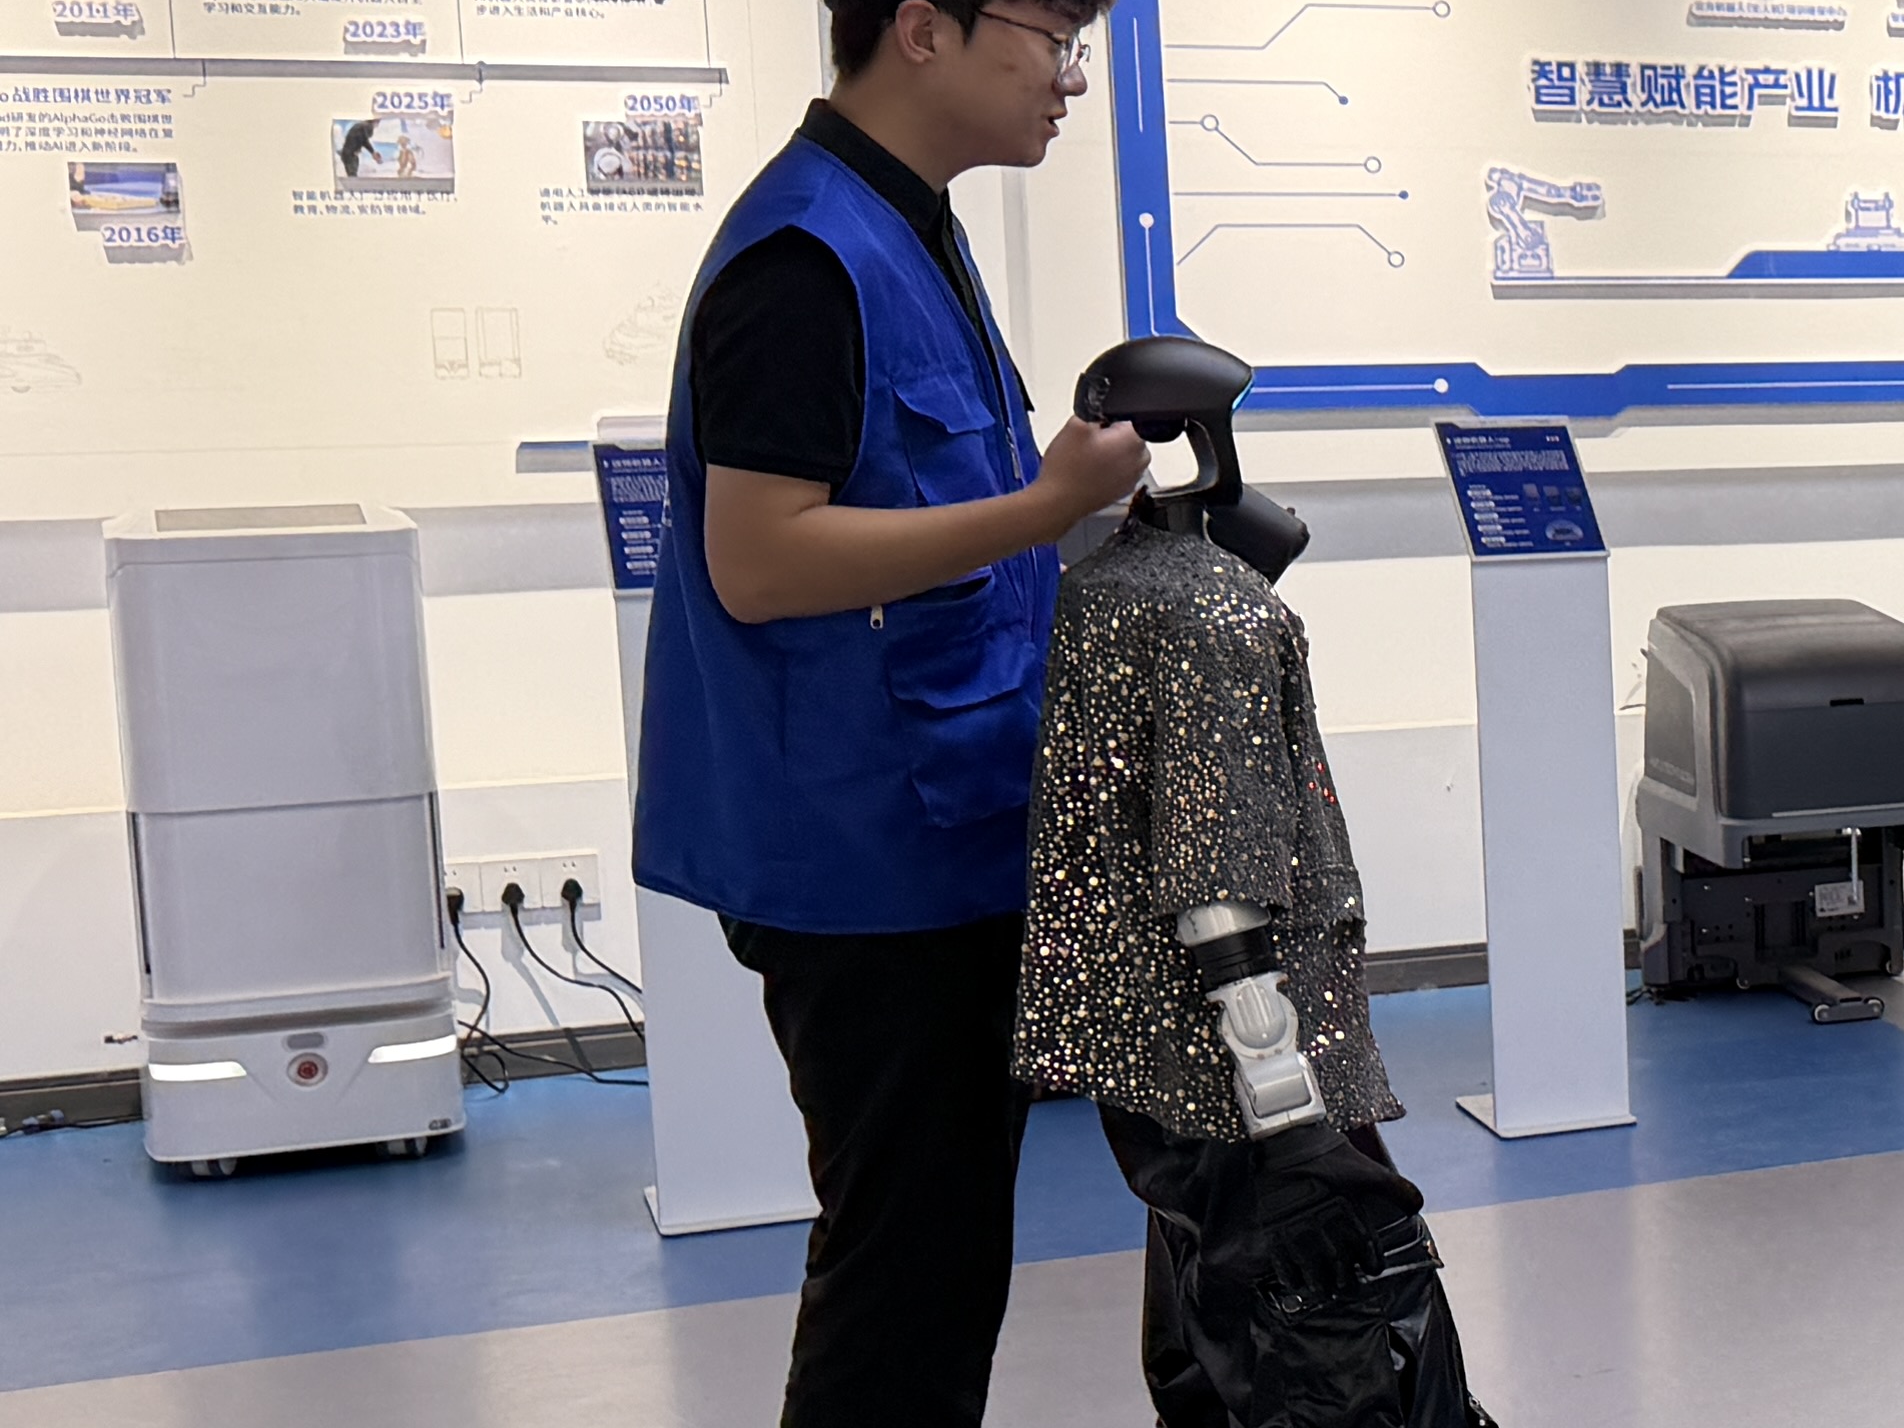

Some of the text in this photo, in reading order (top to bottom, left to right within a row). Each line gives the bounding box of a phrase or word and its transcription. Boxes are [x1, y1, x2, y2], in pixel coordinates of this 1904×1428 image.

[55, 0, 136, 20] 2011年
[348, 20, 425, 40] 2023年
[1531, 59, 1840, 113] 智慧赋能产业
[375, 90, 453, 111] 2025年
[626, 93, 699, 113] 2050年
[103, 225, 184, 244] 2016年
